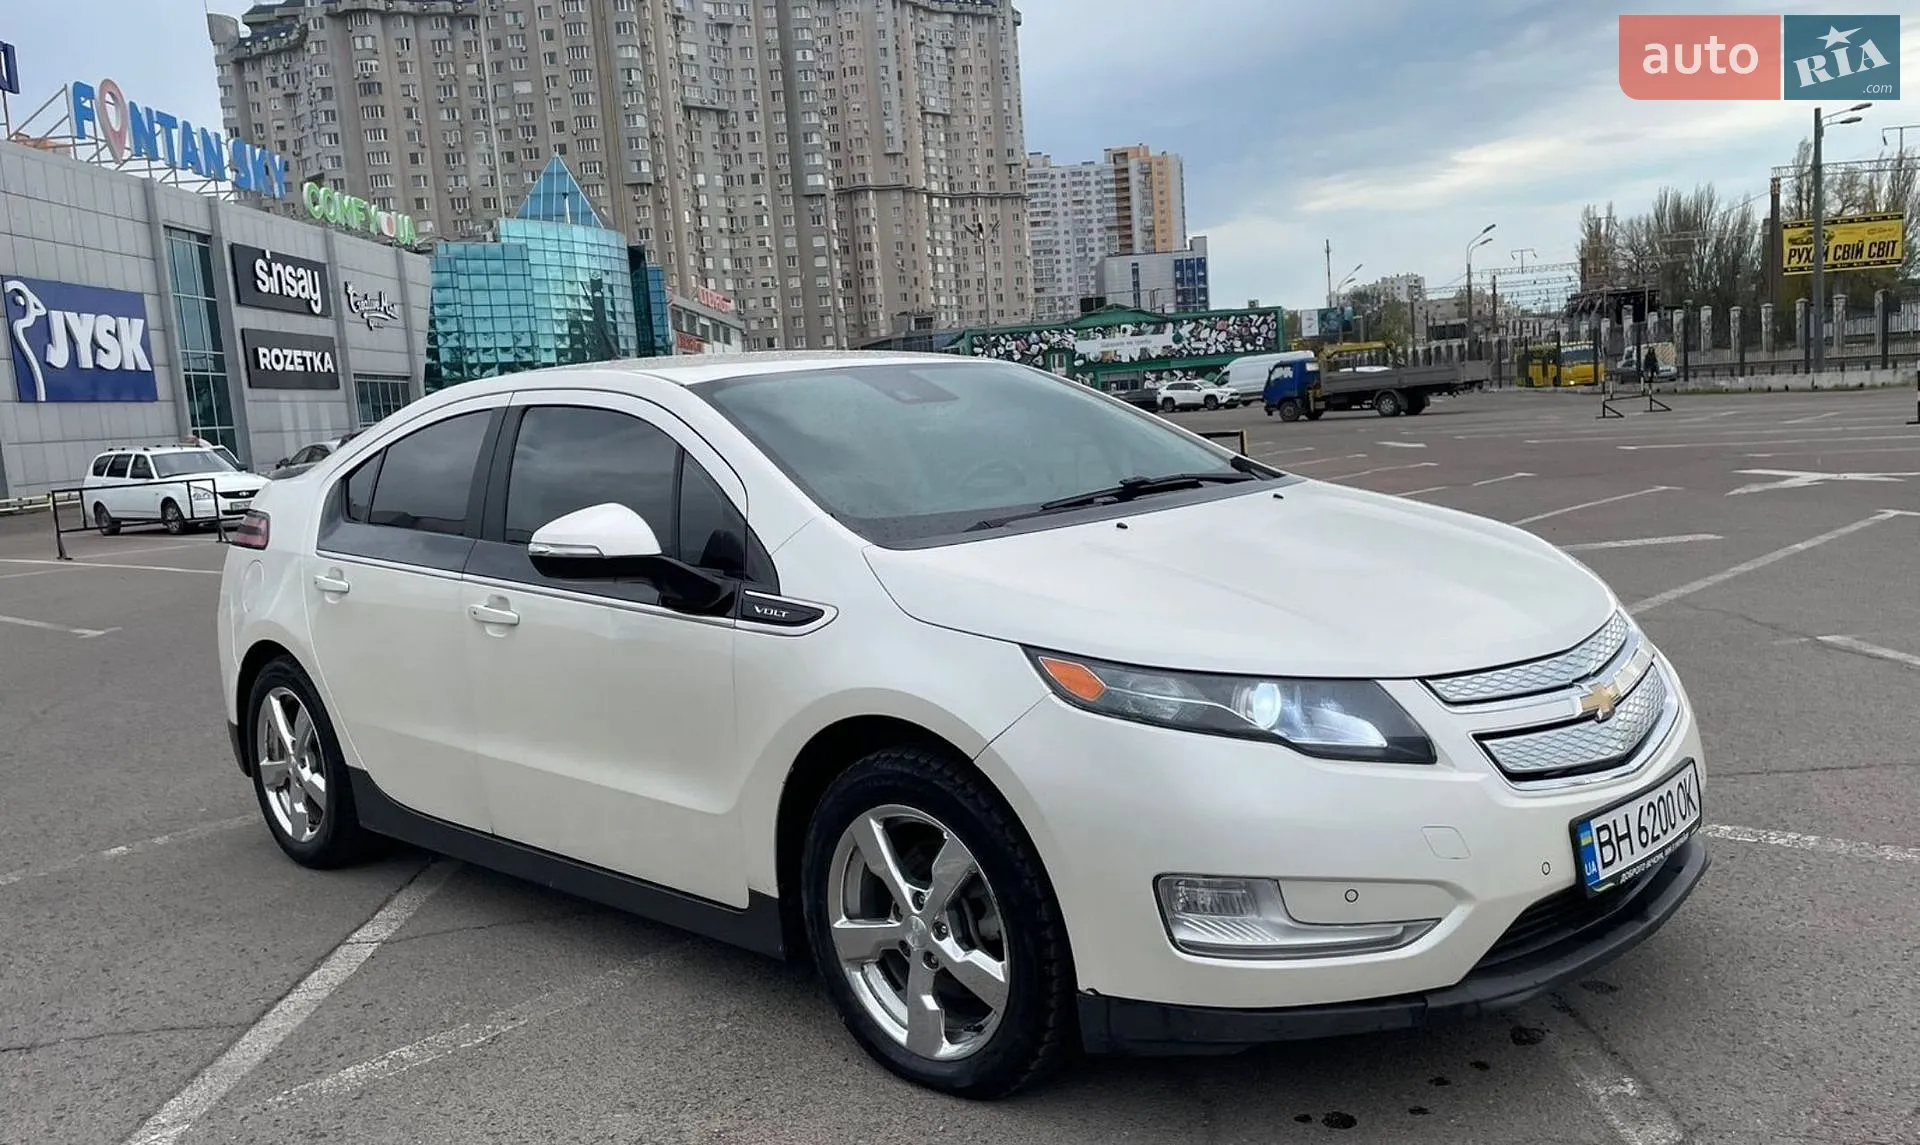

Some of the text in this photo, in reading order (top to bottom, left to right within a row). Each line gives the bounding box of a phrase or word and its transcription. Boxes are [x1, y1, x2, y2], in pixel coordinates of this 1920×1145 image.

[72, 78, 286, 200] FONTAN SKY
[1833, 239, 1865, 261] СВІЙ
[1868, 240, 1898, 259] СВІТ
[254, 249, 322, 315] sinsay
[46, 309, 153, 372] JYSK
[257, 346, 335, 374] ROZETKA
[754, 605, 790, 618] VOLT
[1596, 813, 1634, 869] BH
[1638, 790, 1676, 848] 6200
[1677, 773, 1697, 821] OK
[1584, 861, 1598, 876] UA
